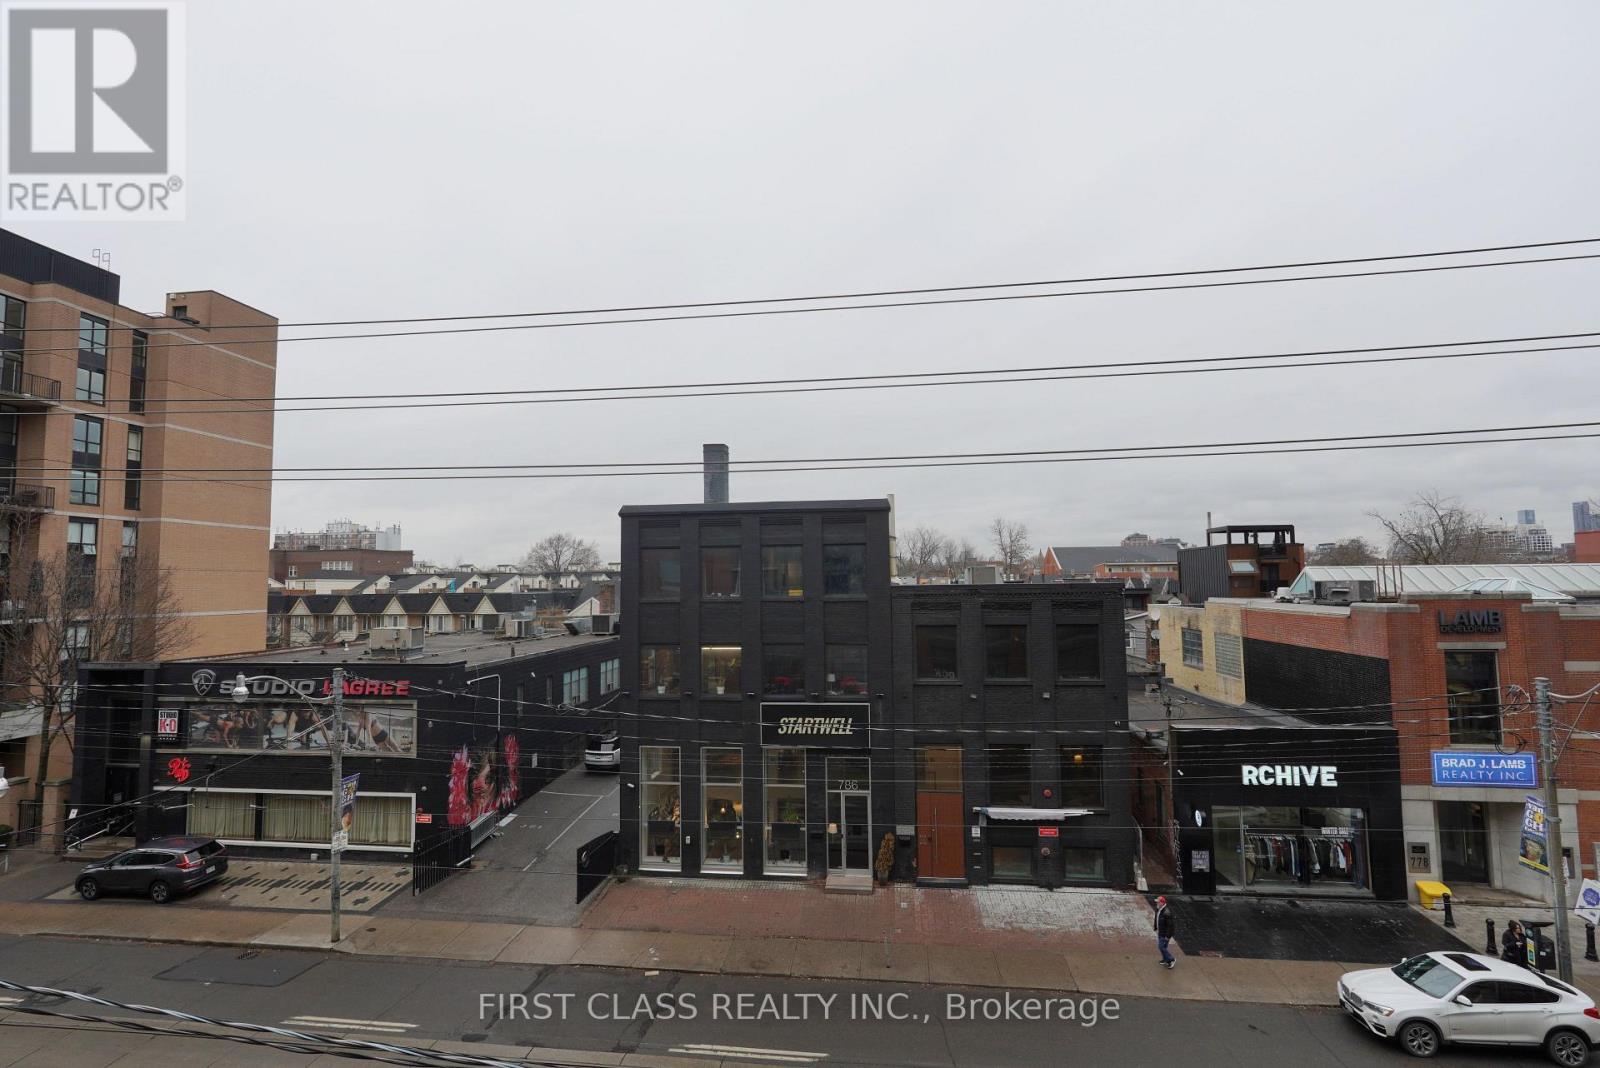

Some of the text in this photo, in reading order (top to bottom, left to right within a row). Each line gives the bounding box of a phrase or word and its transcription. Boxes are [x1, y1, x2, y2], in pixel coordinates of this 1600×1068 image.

[1438, 608, 1503, 626] LAMB
[219, 680, 315, 695] SUDIO
[777, 717, 854, 735] STARTWELL
[1441, 758, 1526, 769] BRAD J. LAMB
[1241, 765, 1338, 787] RCHIVE
[1442, 769, 1526, 780] REALTY INC
[838, 779, 859, 791] 786
